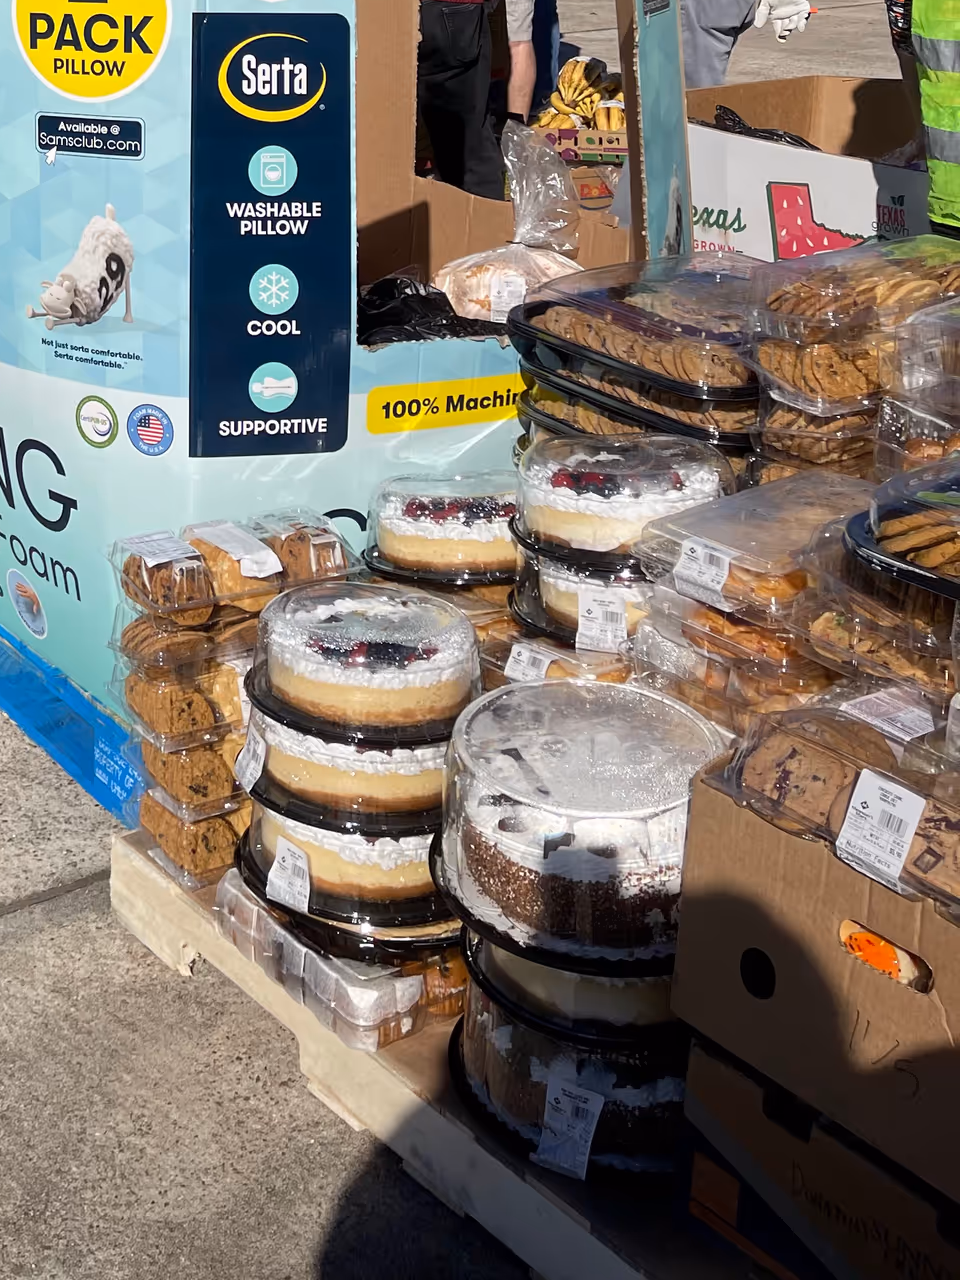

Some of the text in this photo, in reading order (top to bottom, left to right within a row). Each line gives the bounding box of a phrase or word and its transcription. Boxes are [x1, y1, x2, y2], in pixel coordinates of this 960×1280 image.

[29, 12, 154, 54] PACK
[53, 58, 126, 77] PILLOW
[242, 54, 308, 95] Serta
[58, 121, 121, 135] Available @
[40, 132, 141, 151] Samsclub.com
[226, 202, 322, 218] WASHABLE
[692, 205, 747, 233] exas
[876, 204, 906, 228] TEXAS
[240, 220, 309, 235] PILLOW
[693, 239, 735, 252] GROWN
[98, 252, 126, 312] 29
[247, 320, 301, 336] COOL
[41, 337, 143, 361] Not just sorta comfortable.
[54, 350, 125, 369] Serta comfortable.
[381, 388, 520, 419] 100% Machin
[219, 417, 328, 436] SUPPORTIVE
